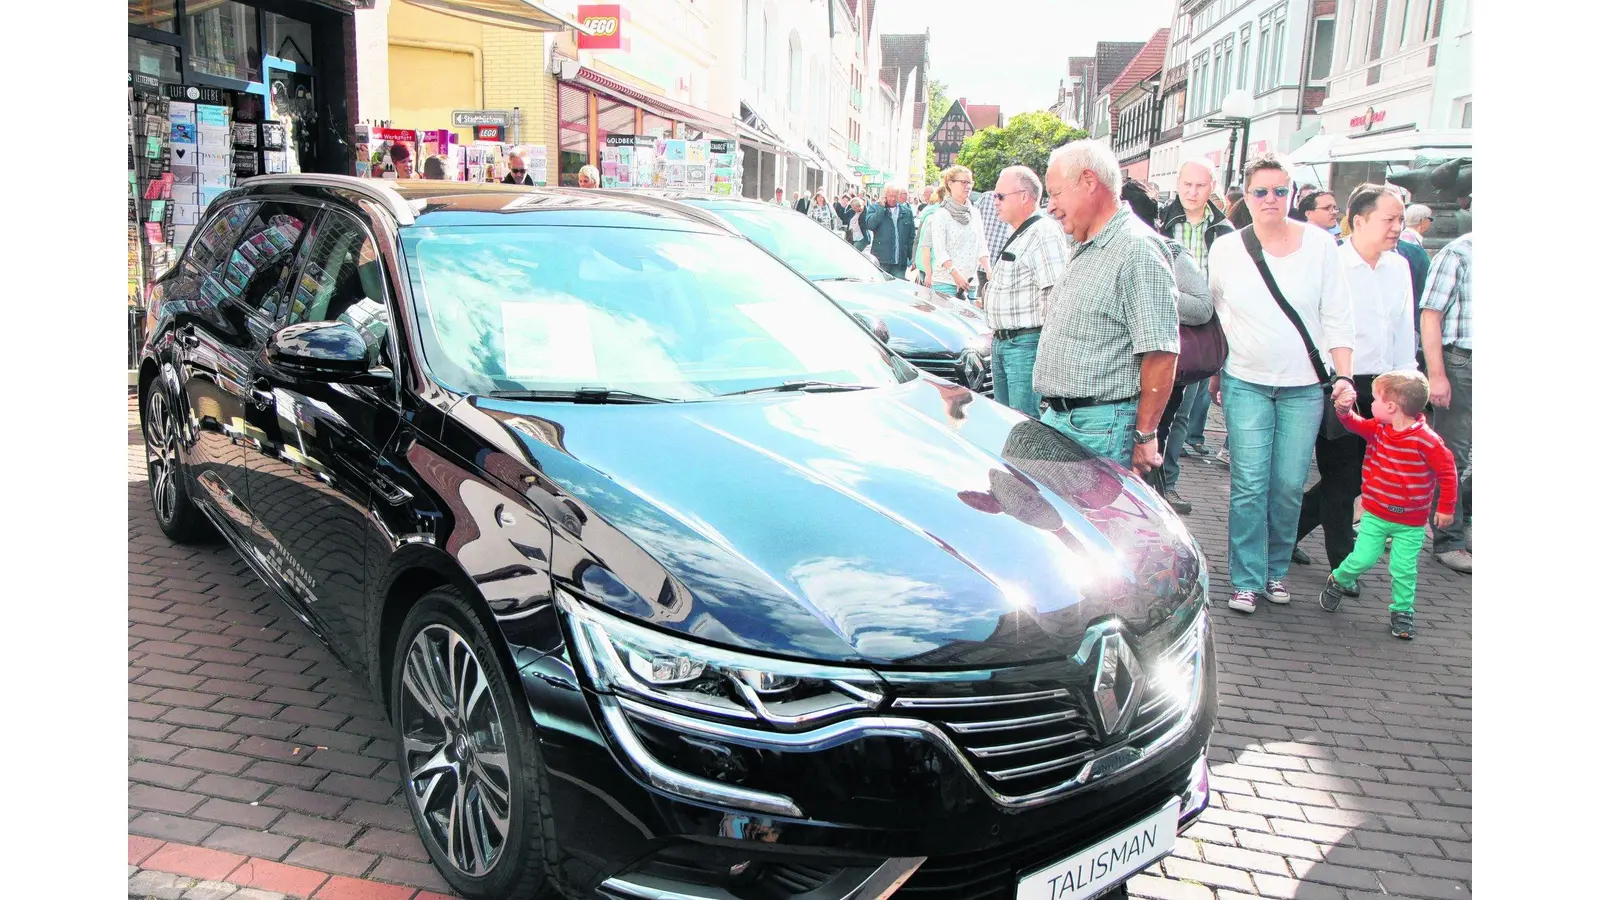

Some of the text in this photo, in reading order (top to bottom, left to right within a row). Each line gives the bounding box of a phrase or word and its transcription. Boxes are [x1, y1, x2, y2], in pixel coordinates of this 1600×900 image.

[170, 86, 186, 98] LUFT
[201, 89, 219, 101] LIEBE
[480, 129, 497, 138] LEGO
[606, 137, 634, 145] GOLDBEK
[1047, 824, 1158, 900] TALISMAN
